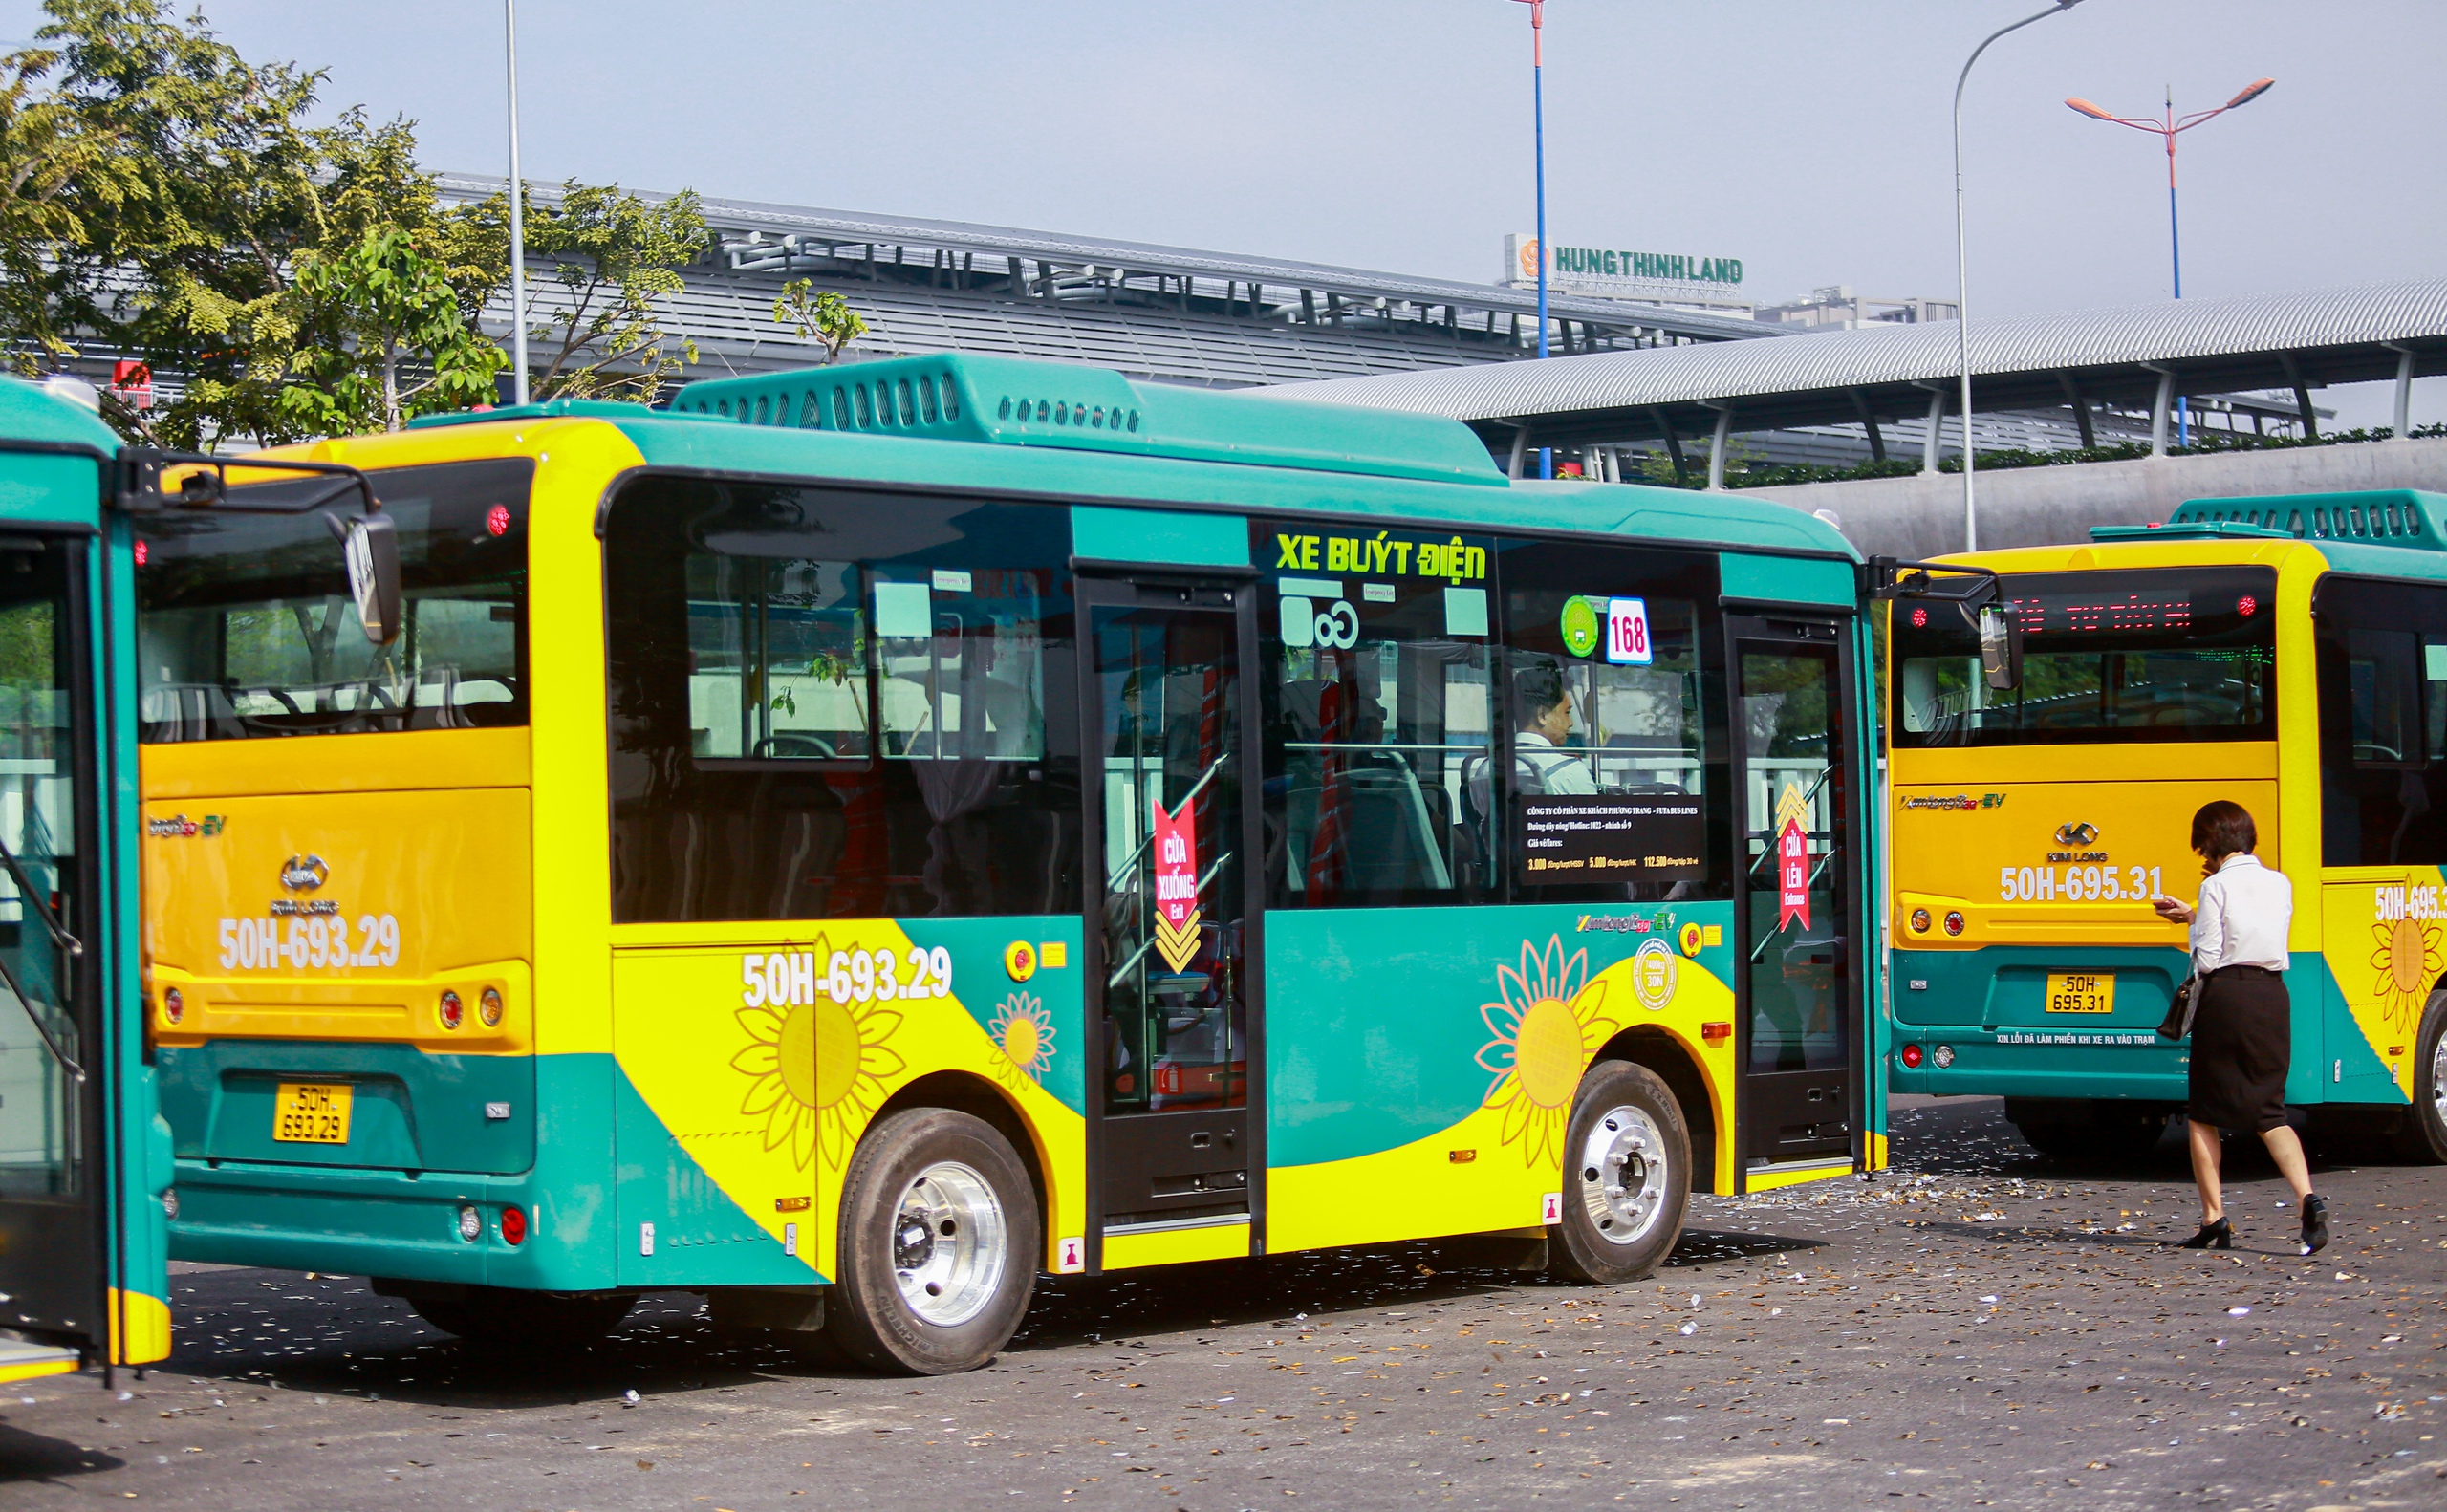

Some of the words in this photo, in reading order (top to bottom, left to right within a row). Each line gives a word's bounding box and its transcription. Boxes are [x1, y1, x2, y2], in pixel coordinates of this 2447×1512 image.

[1277, 533, 1320, 570] XE
[1328, 530, 1413, 575] BUÝT
[1611, 616, 1646, 653] 168
[1545, 807, 1553, 815] TY
[1579, 807, 1587, 815] XE
[1633, 807, 1652, 815] TRANG
[1656, 807, 1670, 815] FUTA
[1671, 807, 1681, 815] BUS
[1681, 807, 1698, 815] LINES
[1627, 821, 1632, 830] 9
[1165, 830, 1187, 864] CỬA
[1786, 829, 1802, 858] CỬA
[1528, 858, 1547, 871] 3.000
[1589, 856, 1606, 868] 5.000
[1644, 855, 1667, 867] 112.500
[2047, 851, 2071, 863] KIM
[2074, 851, 2110, 863] LONG
[1159, 865, 1195, 900] XUỐNG
[1786, 861, 1803, 888] LÊN
[2000, 866, 2165, 901] 50H-695.31
[1784, 892, 1805, 906] Entrance
[1171, 903, 1184, 919] Exit
[219, 914, 401, 969] 50H-693.29
[742, 946, 952, 1007] 50H-693.29
[1645, 960, 1666, 974] 7400kg
[1647, 975, 1663, 987] 30N
[2066, 977, 2095, 992] 50H
[2053, 995, 2105, 1011] 695.31
[1997, 1034, 2008, 1043] XIN
[2011, 1031, 2023, 1043] LỖI
[2025, 1033, 2034, 1044] ĐÃ
[2037, 1033, 2052, 1044] LÀM
[2078, 1035, 2090, 1044] KHI
[2092, 1035, 2103, 1044] XE
[2105, 1035, 2115, 1044] RA
[2117, 1033, 2132, 1044] VÀO
[2133, 1035, 2155, 1046] TRẠM
[298, 1087, 331, 1112] 50H
[283, 1114, 340, 1139] 693.29
